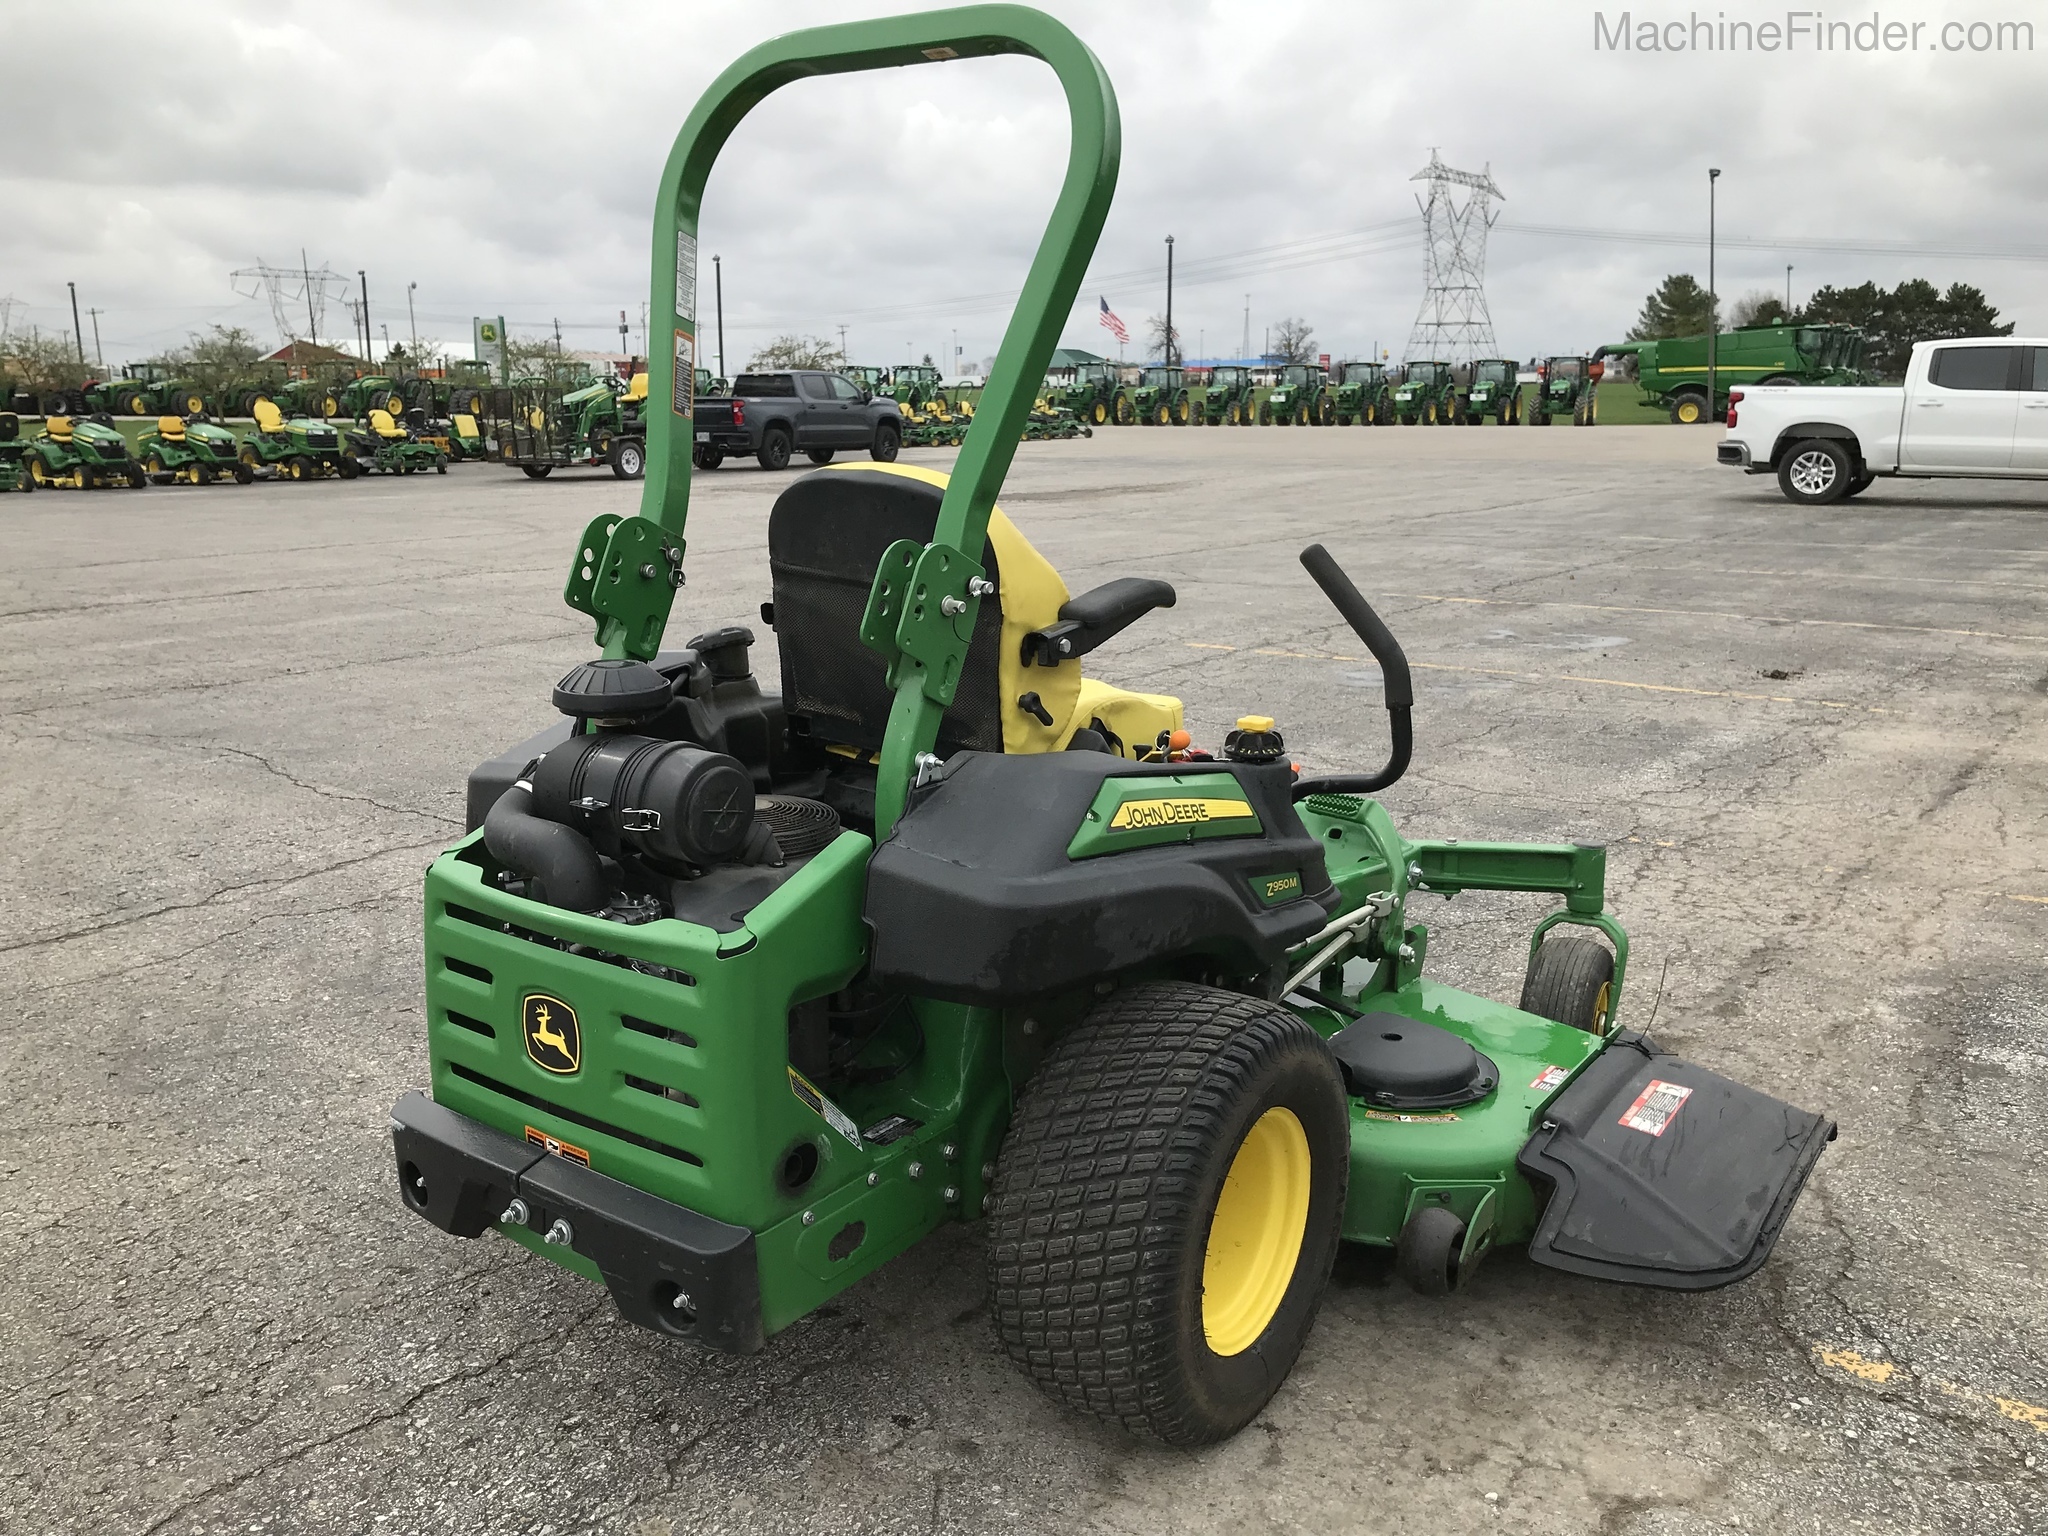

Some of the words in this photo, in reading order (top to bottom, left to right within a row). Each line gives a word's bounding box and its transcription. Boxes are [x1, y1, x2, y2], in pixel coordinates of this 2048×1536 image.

[1126, 805, 1163, 826] JOHN
[1162, 803, 1208, 820] DEERE
[1266, 877, 1297, 897] Z950M
